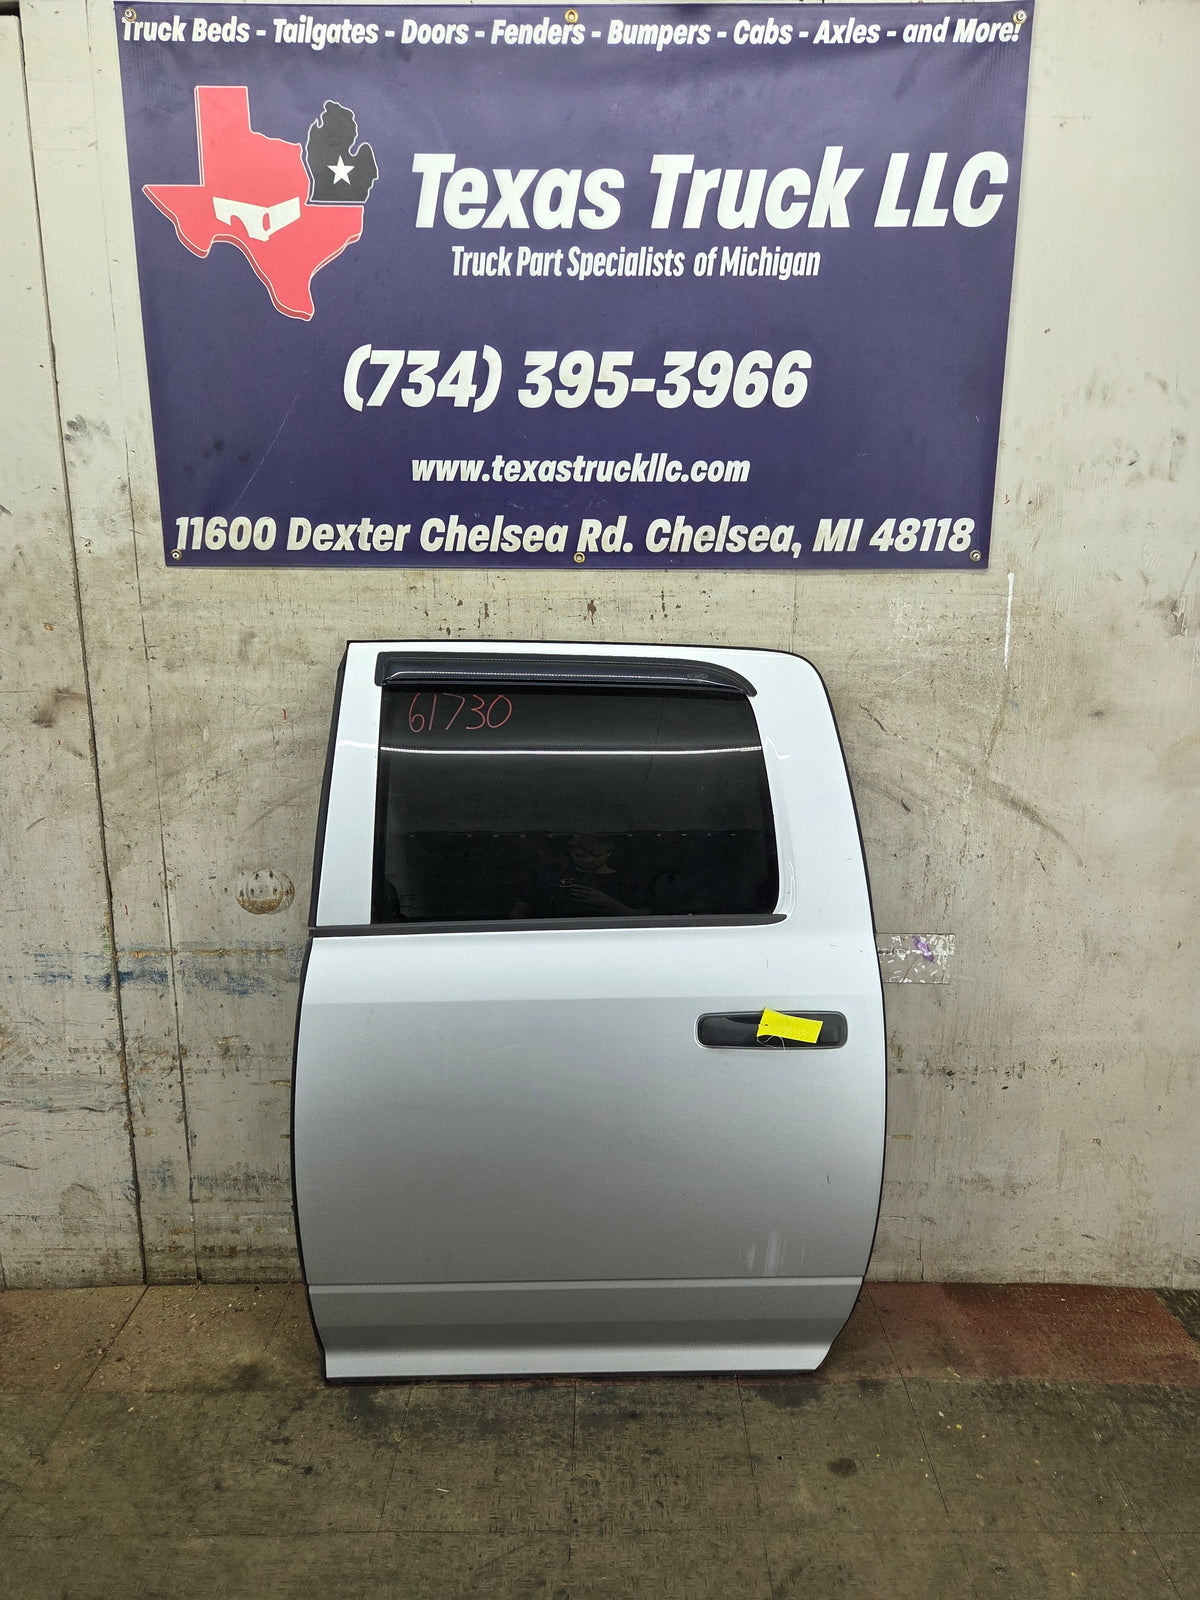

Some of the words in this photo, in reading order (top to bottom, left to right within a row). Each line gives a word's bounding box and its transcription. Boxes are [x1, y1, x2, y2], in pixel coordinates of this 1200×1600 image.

[121, 15, 188, 42] Truck
[191, 15, 251, 43] Beds
[272, 15, 380, 51] Tailgates
[400, 18, 470, 45] Doors
[490, 16, 586, 45] Fenders
[606, 19, 712, 52] Bumpers
[733, 16, 794, 45] Cabs
[812, 16, 882, 44] Axles
[902, 16, 949, 44] and
[952, 18, 1022, 44] More!
[411, 152, 625, 230] Texas
[649, 145, 865, 230] Truck
[873, 150, 1009, 228] LLC
[451, 245, 513, 277] Truck
[516, 245, 564, 277] Part
[566, 245, 686, 281] Specialists
[693, 246, 719, 277] of
[719, 245, 821, 281] Michigan
[343, 343, 503, 413] (734)
[517, 349, 813, 409] 395-3966
[411, 452, 751, 483] www.texastruckllc.com
[175, 516, 277, 551] 11600
[286, 517, 412, 552] Dexter
[420, 514, 569, 553] Chelsea
[576, 515, 634, 553] Rd.
[645, 515, 802, 559] Chelsea,
[812, 518, 864, 552] MI
[868, 517, 976, 552] 48118
[408, 692, 513, 733] 61730
